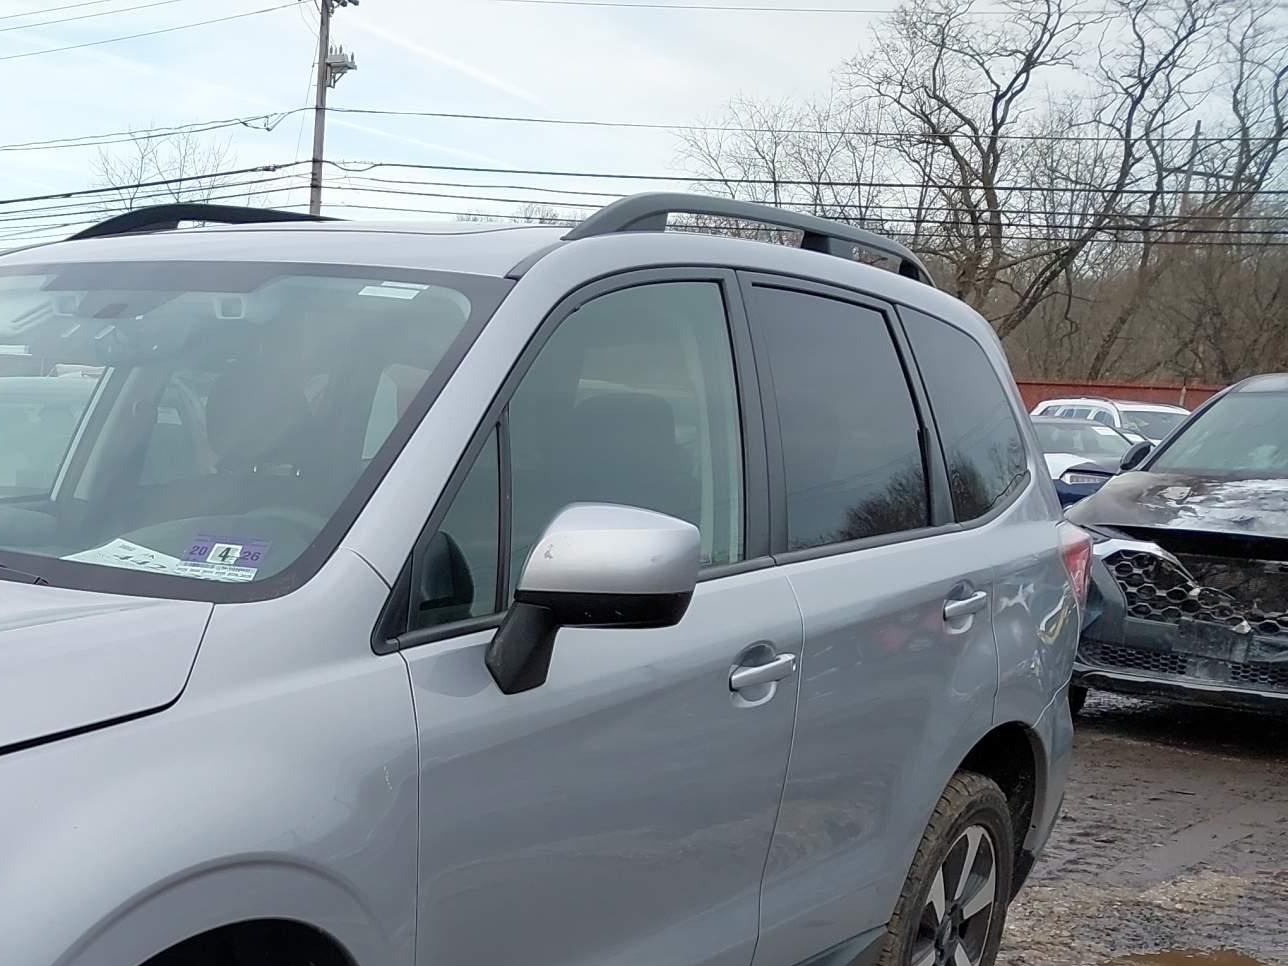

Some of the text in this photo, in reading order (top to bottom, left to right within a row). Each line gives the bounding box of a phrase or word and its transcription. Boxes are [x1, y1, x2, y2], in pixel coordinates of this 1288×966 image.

[189, 545, 262, 562] 20 4 26
